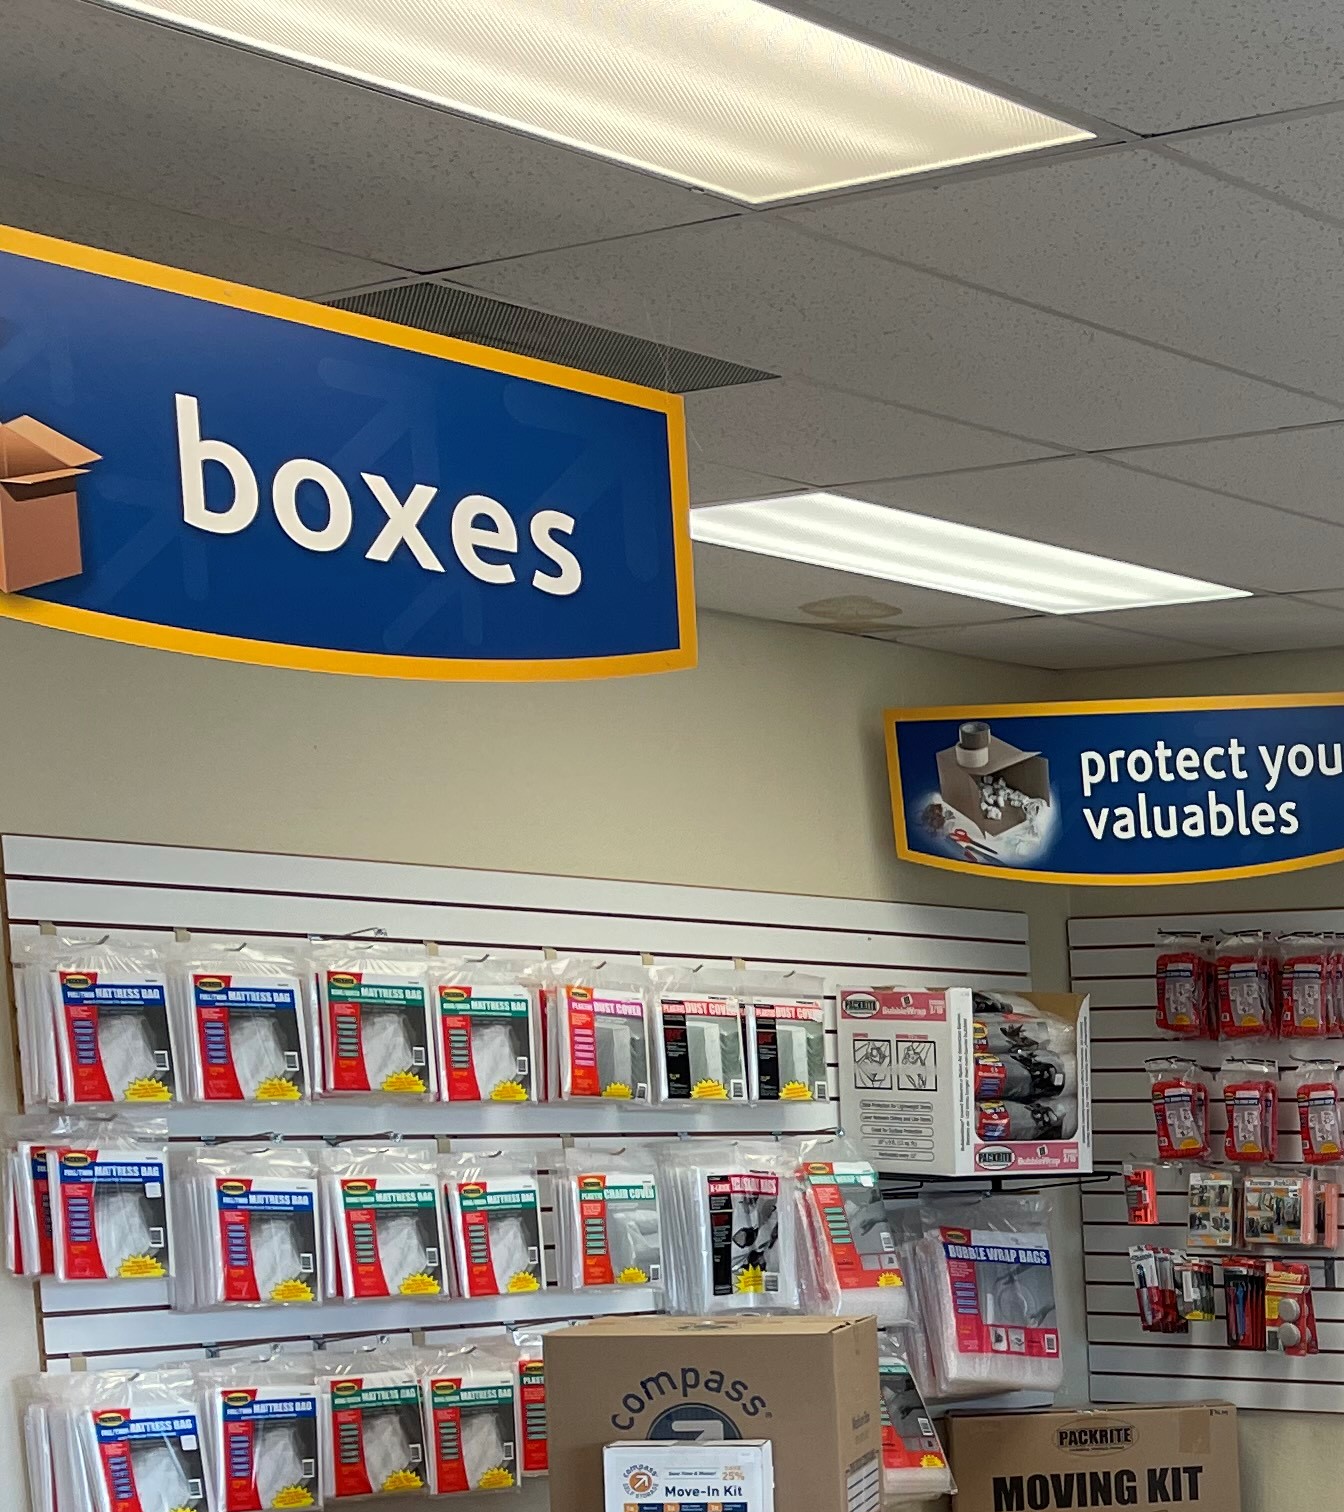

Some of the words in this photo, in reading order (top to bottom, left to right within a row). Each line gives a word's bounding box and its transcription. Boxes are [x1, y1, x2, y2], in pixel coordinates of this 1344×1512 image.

[174, 393, 583, 596] boxes
[1080, 738, 1248, 796] protect
[1082, 790, 1300, 840] valuables
[95, 988, 140, 999] MATTRESS
[228, 991, 272, 1003] MATTRESS
[360, 987, 405, 999] MATTRESS
[593, 1001, 621, 1014] DUST
[621, 1003, 642, 1016] COVER
[684, 1002, 708, 1015] DUST
[94, 1166, 140, 1177] MATTRESS
[947, 1244, 986, 1260] BUBBLE
[986, 1247, 1016, 1263] WRAP
[1018, 1249, 1047, 1265] BAGS
[611, 1366, 767, 1431] compass
[1058, 1426, 1132, 1446] PACKRITE
[721, 1471, 745, 1481] 25%
[665, 1486, 720, 1497] Move-In
[724, 1485, 743, 1497] Kit
[992, 1468, 1138, 1512] MOVING
[1147, 1465, 1203, 1504] KIT
